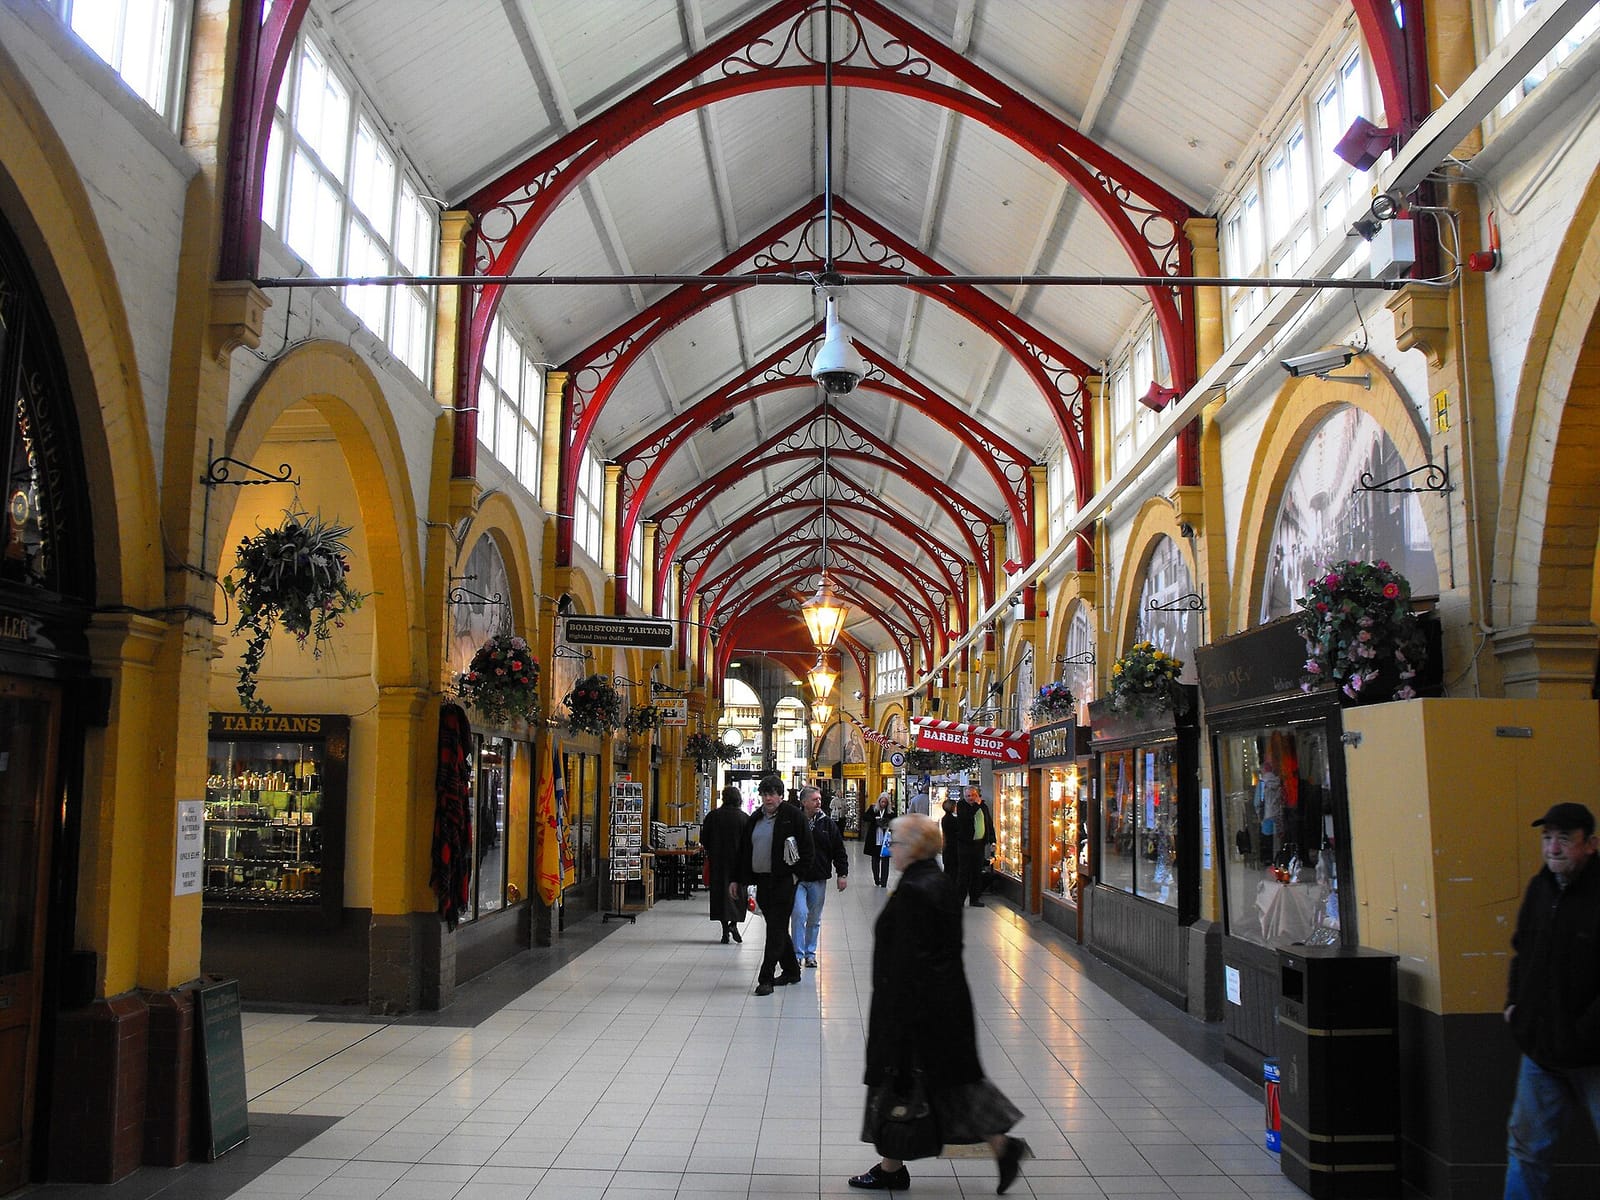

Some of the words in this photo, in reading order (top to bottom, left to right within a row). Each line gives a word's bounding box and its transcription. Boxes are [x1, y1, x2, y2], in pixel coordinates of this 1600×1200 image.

[569, 624, 625, 633] BOARSTONE
[628, 626, 671, 635] TARTANS
[222, 716, 321, 732] TARTANS
[923, 730, 969, 744] BARBER
[974, 738, 1004, 749] SHOP
[972, 748, 1002, 758] ENTRANCE
